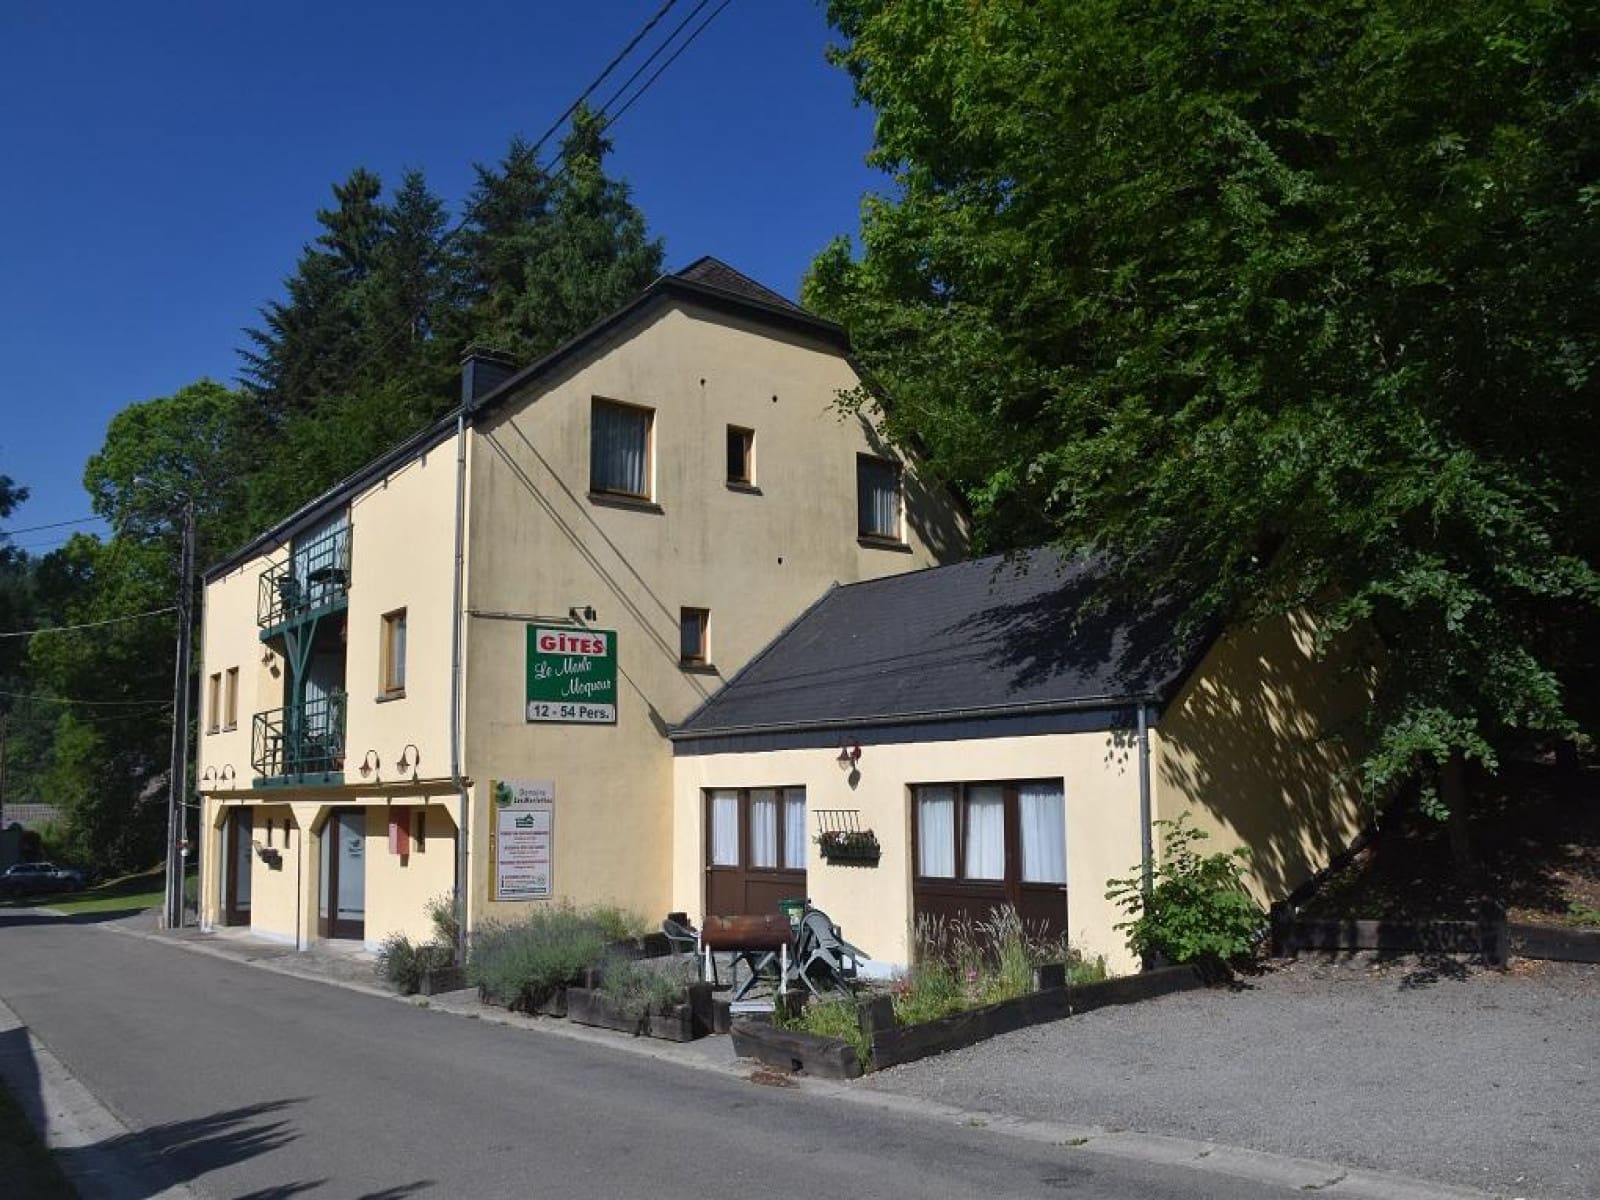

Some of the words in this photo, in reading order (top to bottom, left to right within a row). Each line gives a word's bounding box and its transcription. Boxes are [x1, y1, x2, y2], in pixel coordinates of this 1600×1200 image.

[540, 633, 603, 654] GÎTES
[534, 660, 552, 680] Le
[561, 677, 611, 697] Moqueur
[534, 705, 550, 717] 12
[560, 705, 576, 718] 54
[579, 706, 609, 719] Pers.
